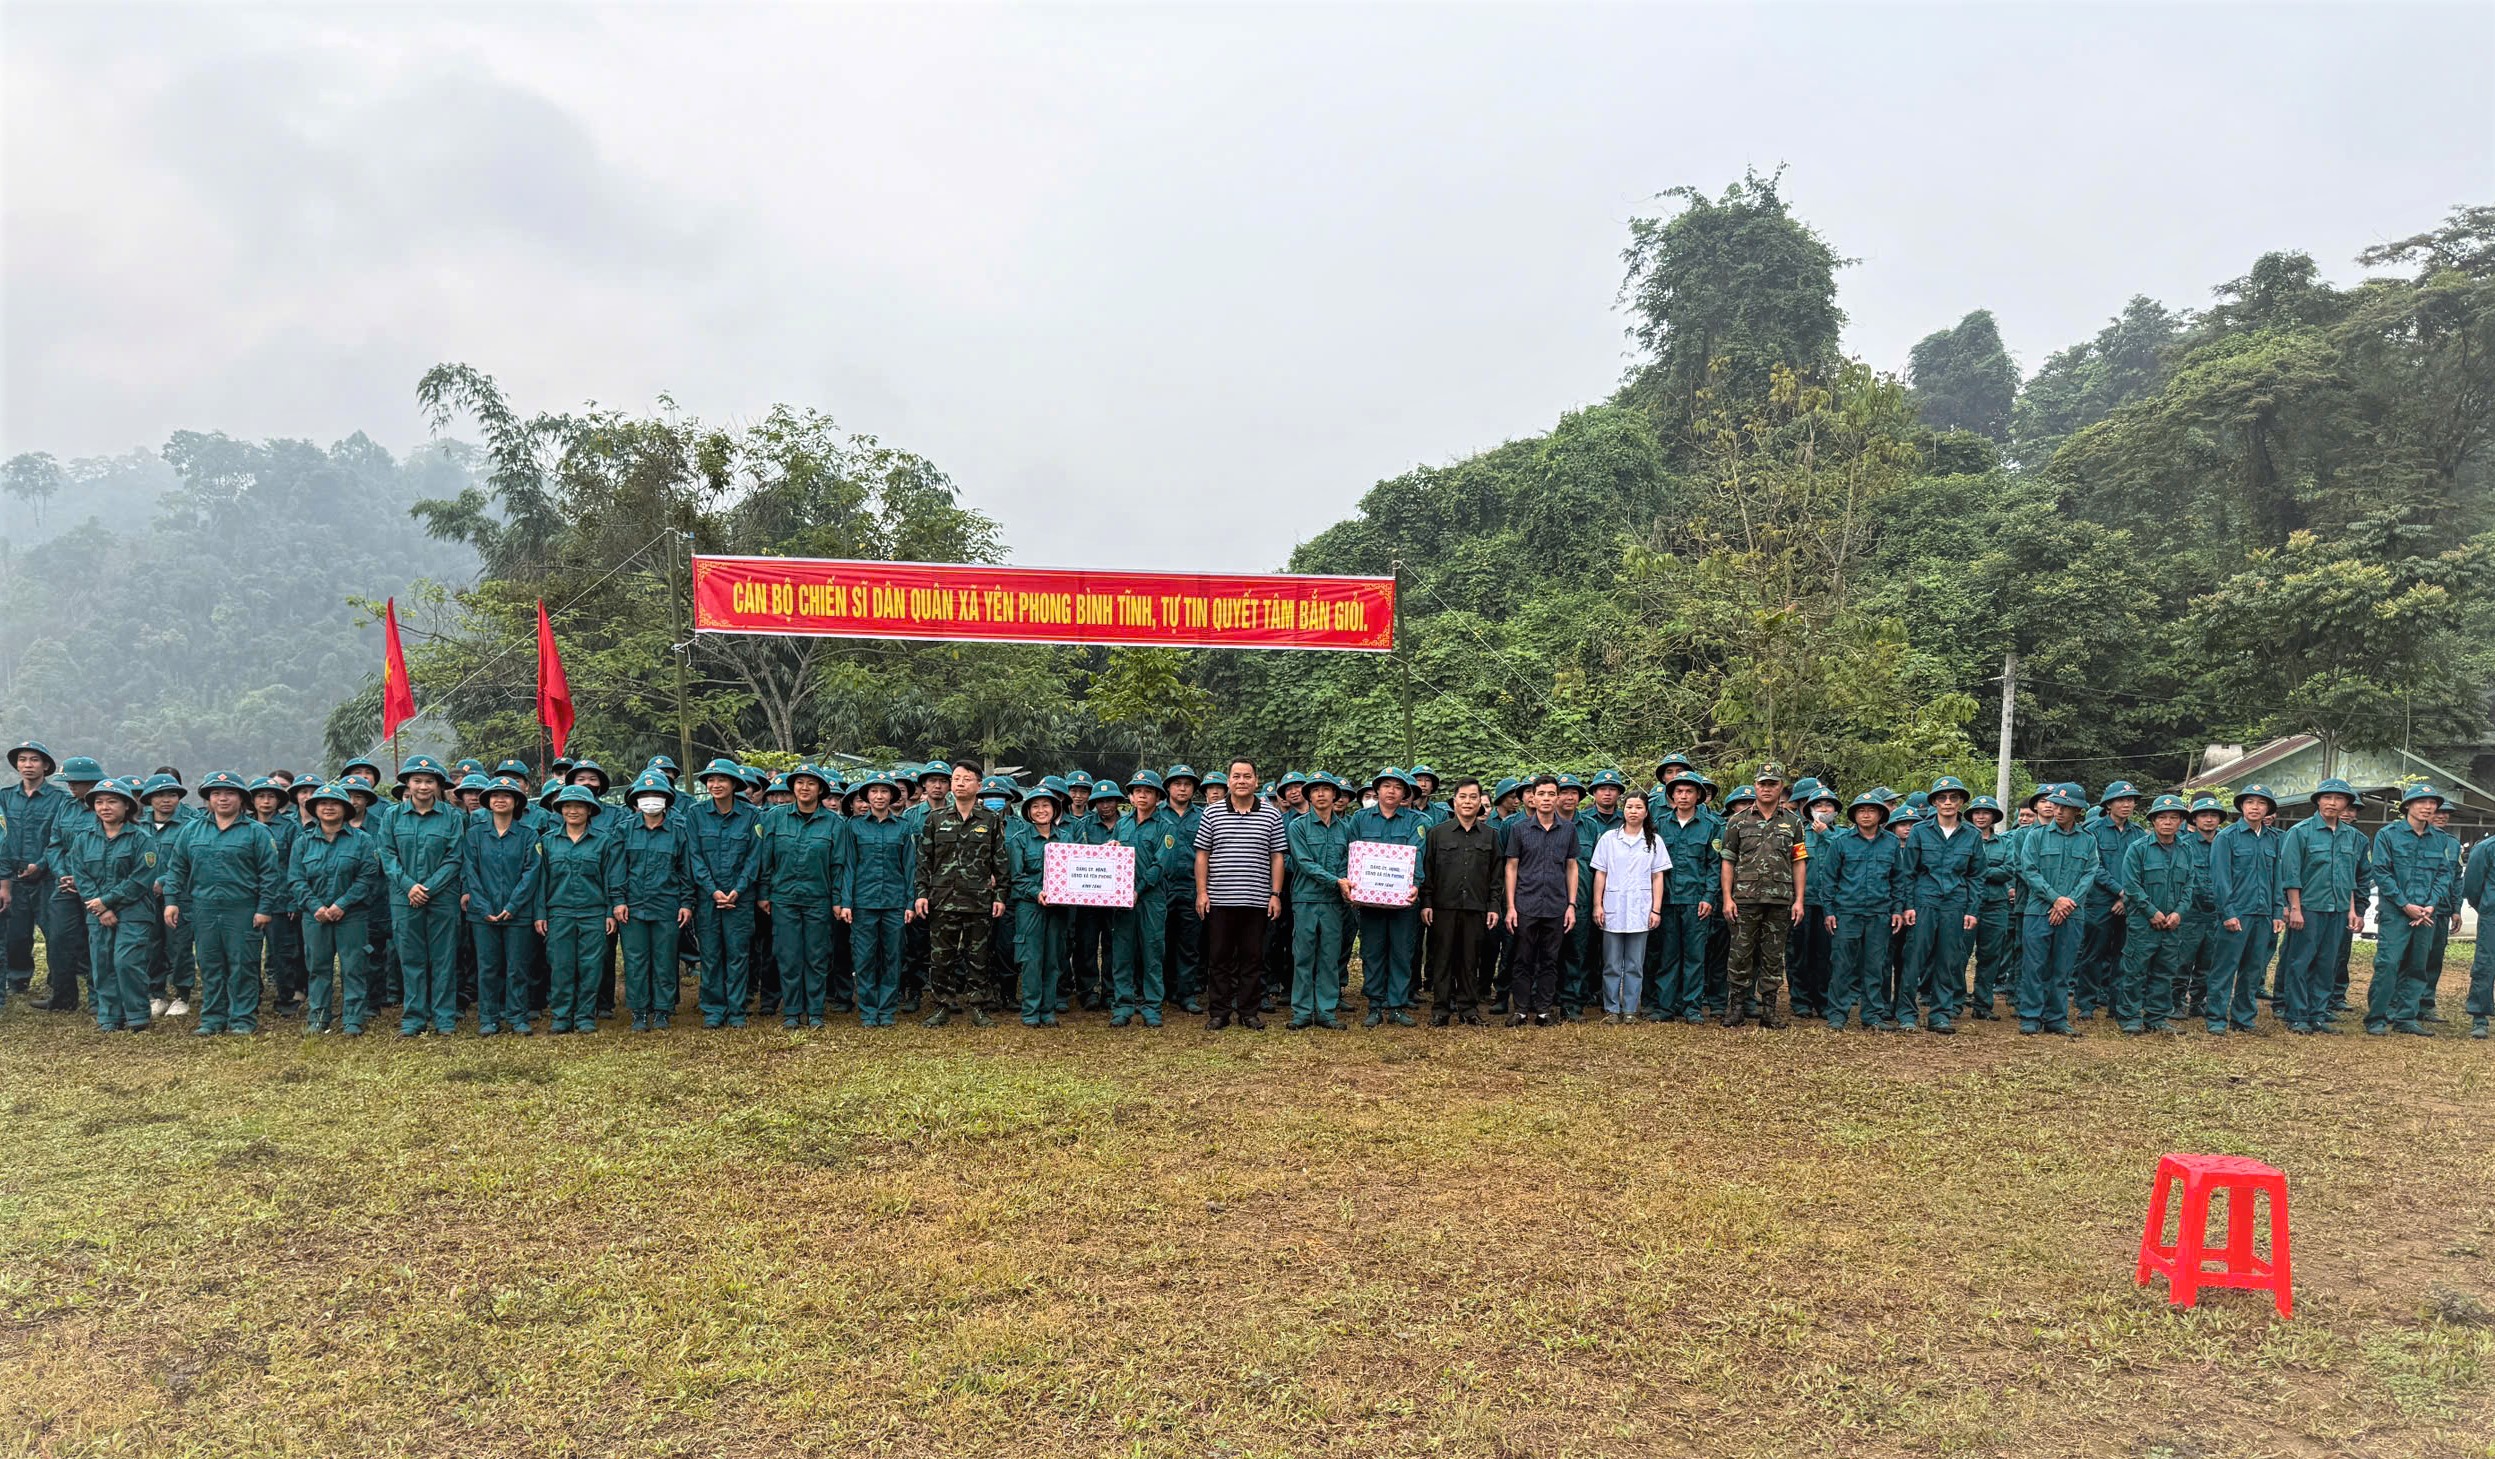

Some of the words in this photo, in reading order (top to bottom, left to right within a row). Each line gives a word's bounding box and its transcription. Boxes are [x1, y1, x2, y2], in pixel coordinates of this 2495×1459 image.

[733, 576, 767, 614] CÁN
[772, 577, 794, 622] BỘ
[798, 575, 847, 617] CHIẾN
[851, 581, 868, 618] SĨ
[873, 581, 906, 619] DÂN
[910, 583, 954, 623] QUÂN
[958, 584, 980, 621] XÃ
[984, 584, 1014, 623] YÊN
[1018, 592, 1071, 624] PHONG
[1076, 587, 1113, 625] BÌNH
[1117, 589, 1157, 630] TĨNH,
[1161, 593, 1181, 634] TỰ
[1183, 596, 1208, 628] TIN
[1212, 588, 1259, 632] QUYẾT
[1263, 592, 1295, 631] TÂM
[1299, 589, 1331, 631] BẮN
[1334, 592, 1369, 632] GIỎI.
